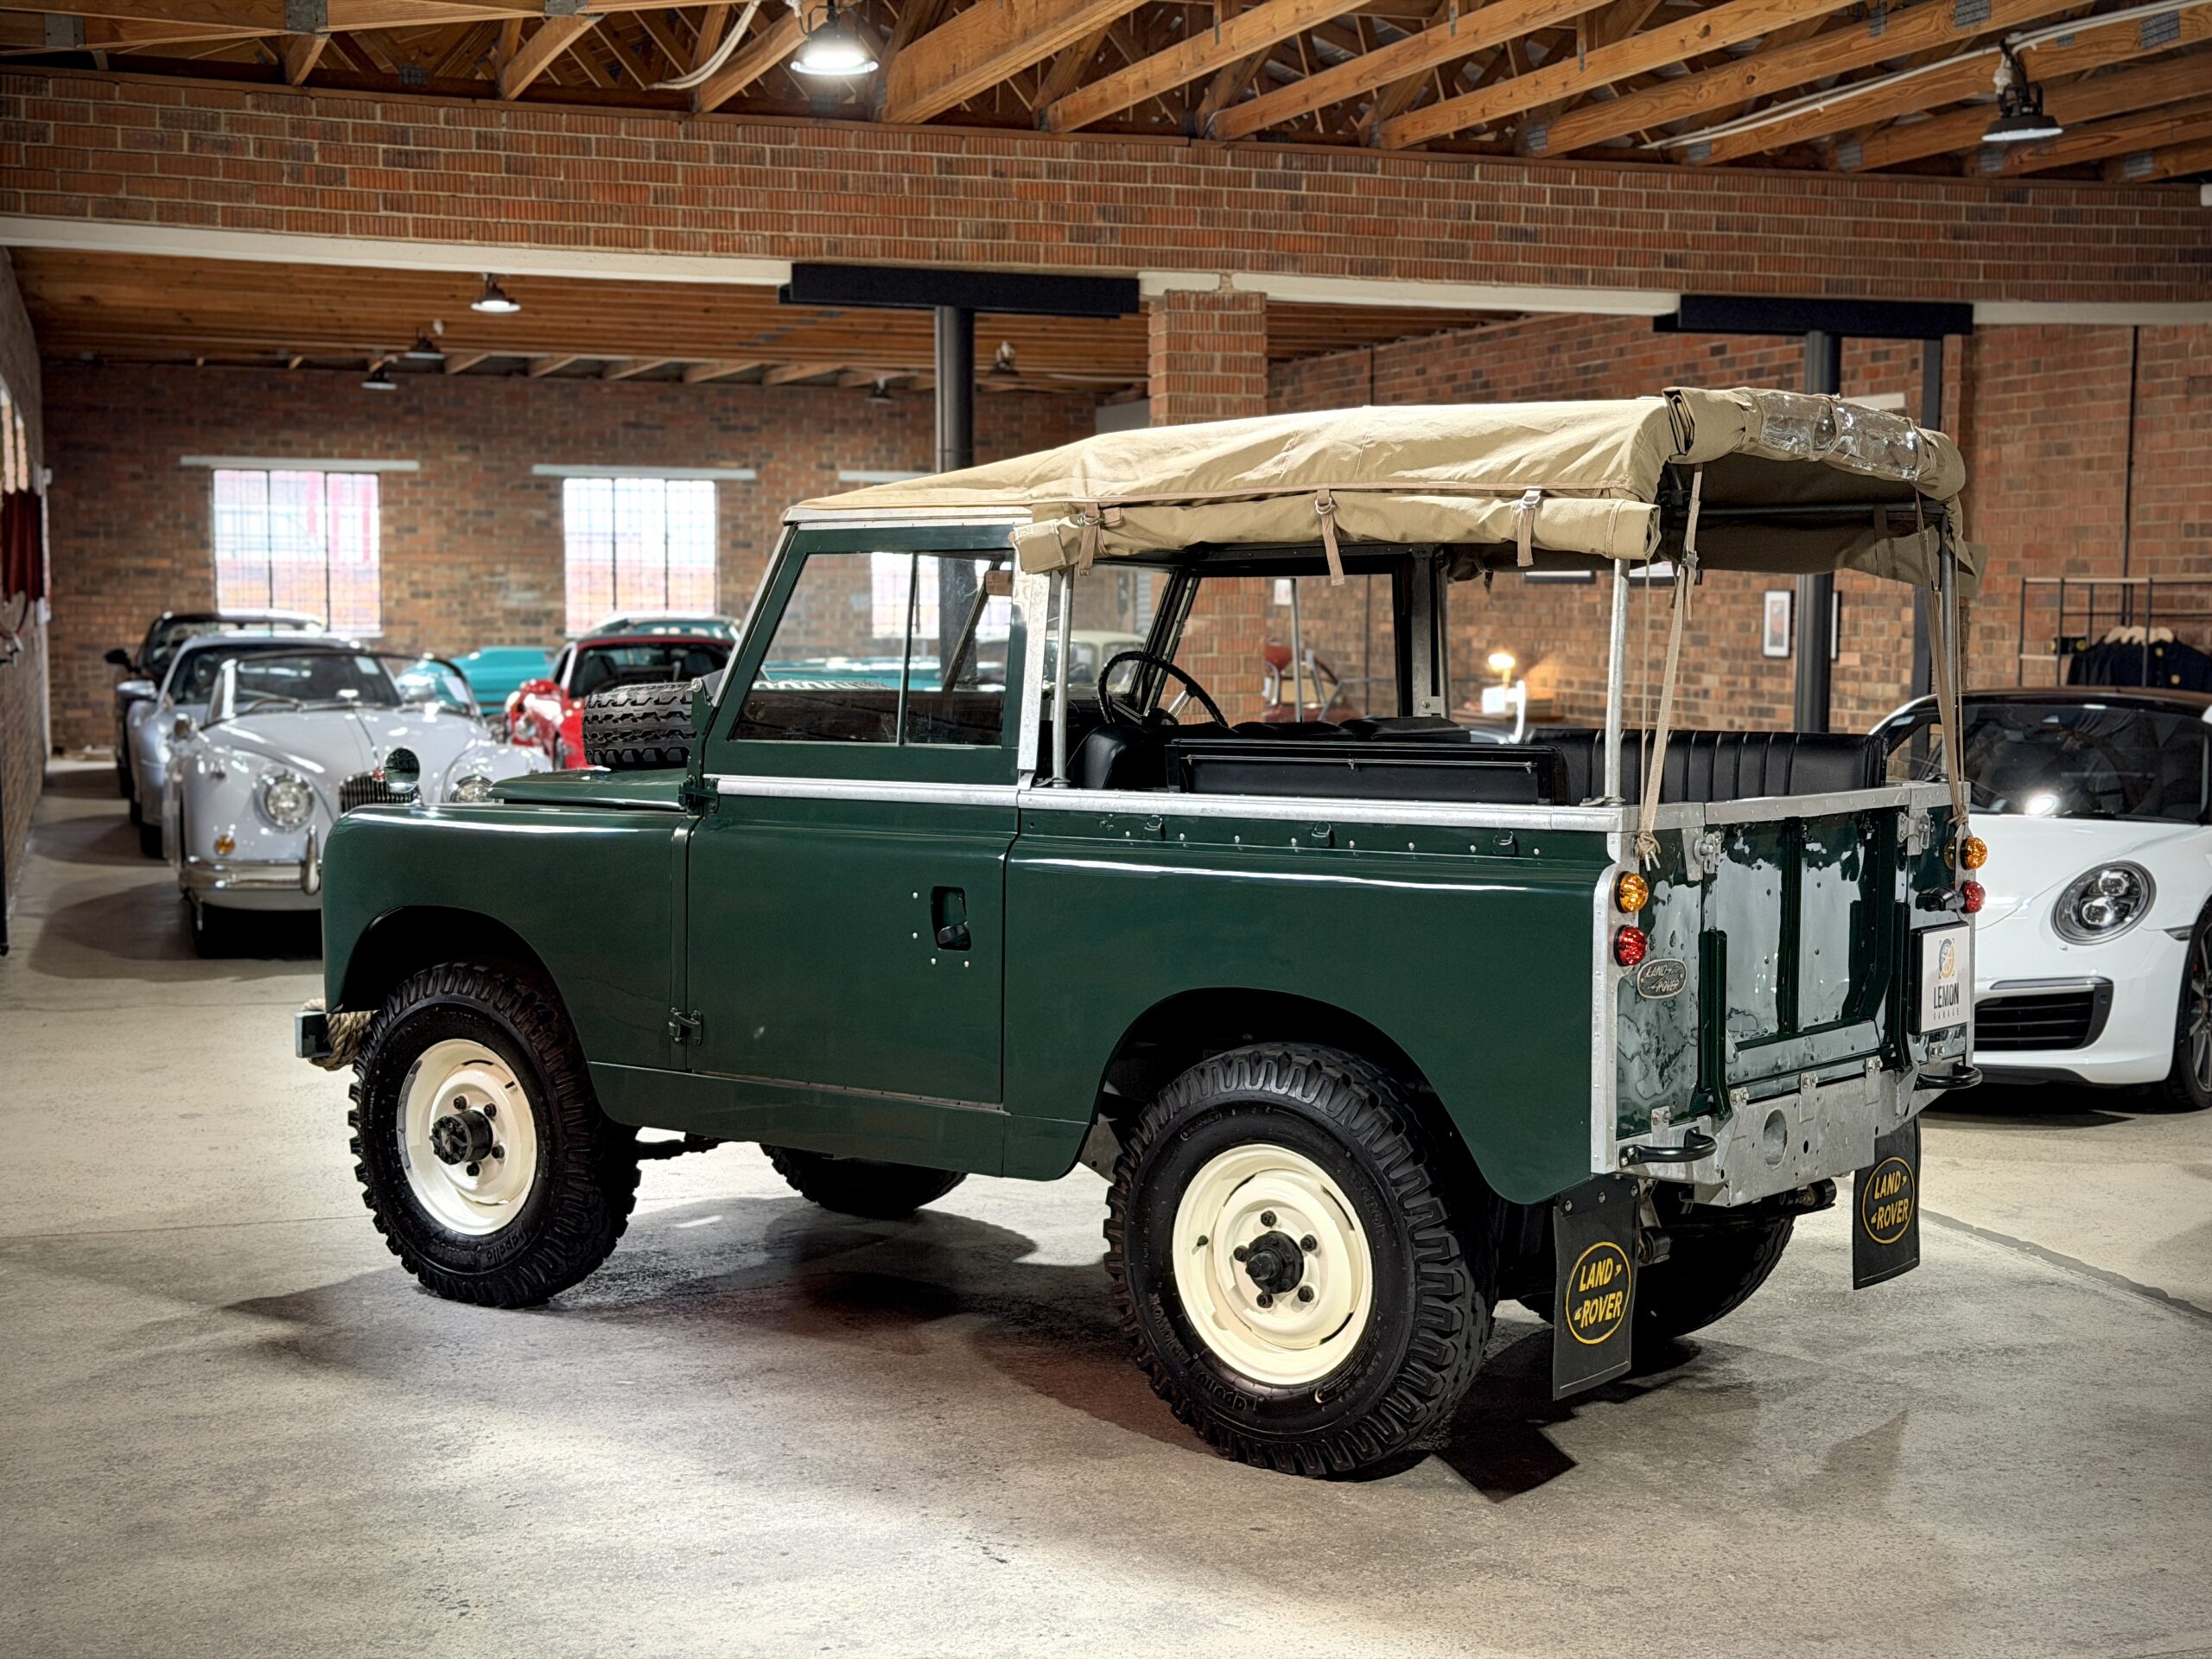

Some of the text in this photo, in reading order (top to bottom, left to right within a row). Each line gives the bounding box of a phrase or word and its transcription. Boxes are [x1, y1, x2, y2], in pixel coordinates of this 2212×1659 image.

[1645, 964, 1667, 977] LAND
[1655, 979, 1680, 993] ROVER
[1934, 982, 1959, 1009] LEMON
[1874, 1170, 1901, 1200] LAND
[1876, 1198, 1909, 1230] ROVER
[486, 1236, 519, 1265] apollo
[1579, 1257, 1614, 1292] LAND
[1580, 1291, 1623, 1329] ROVER
